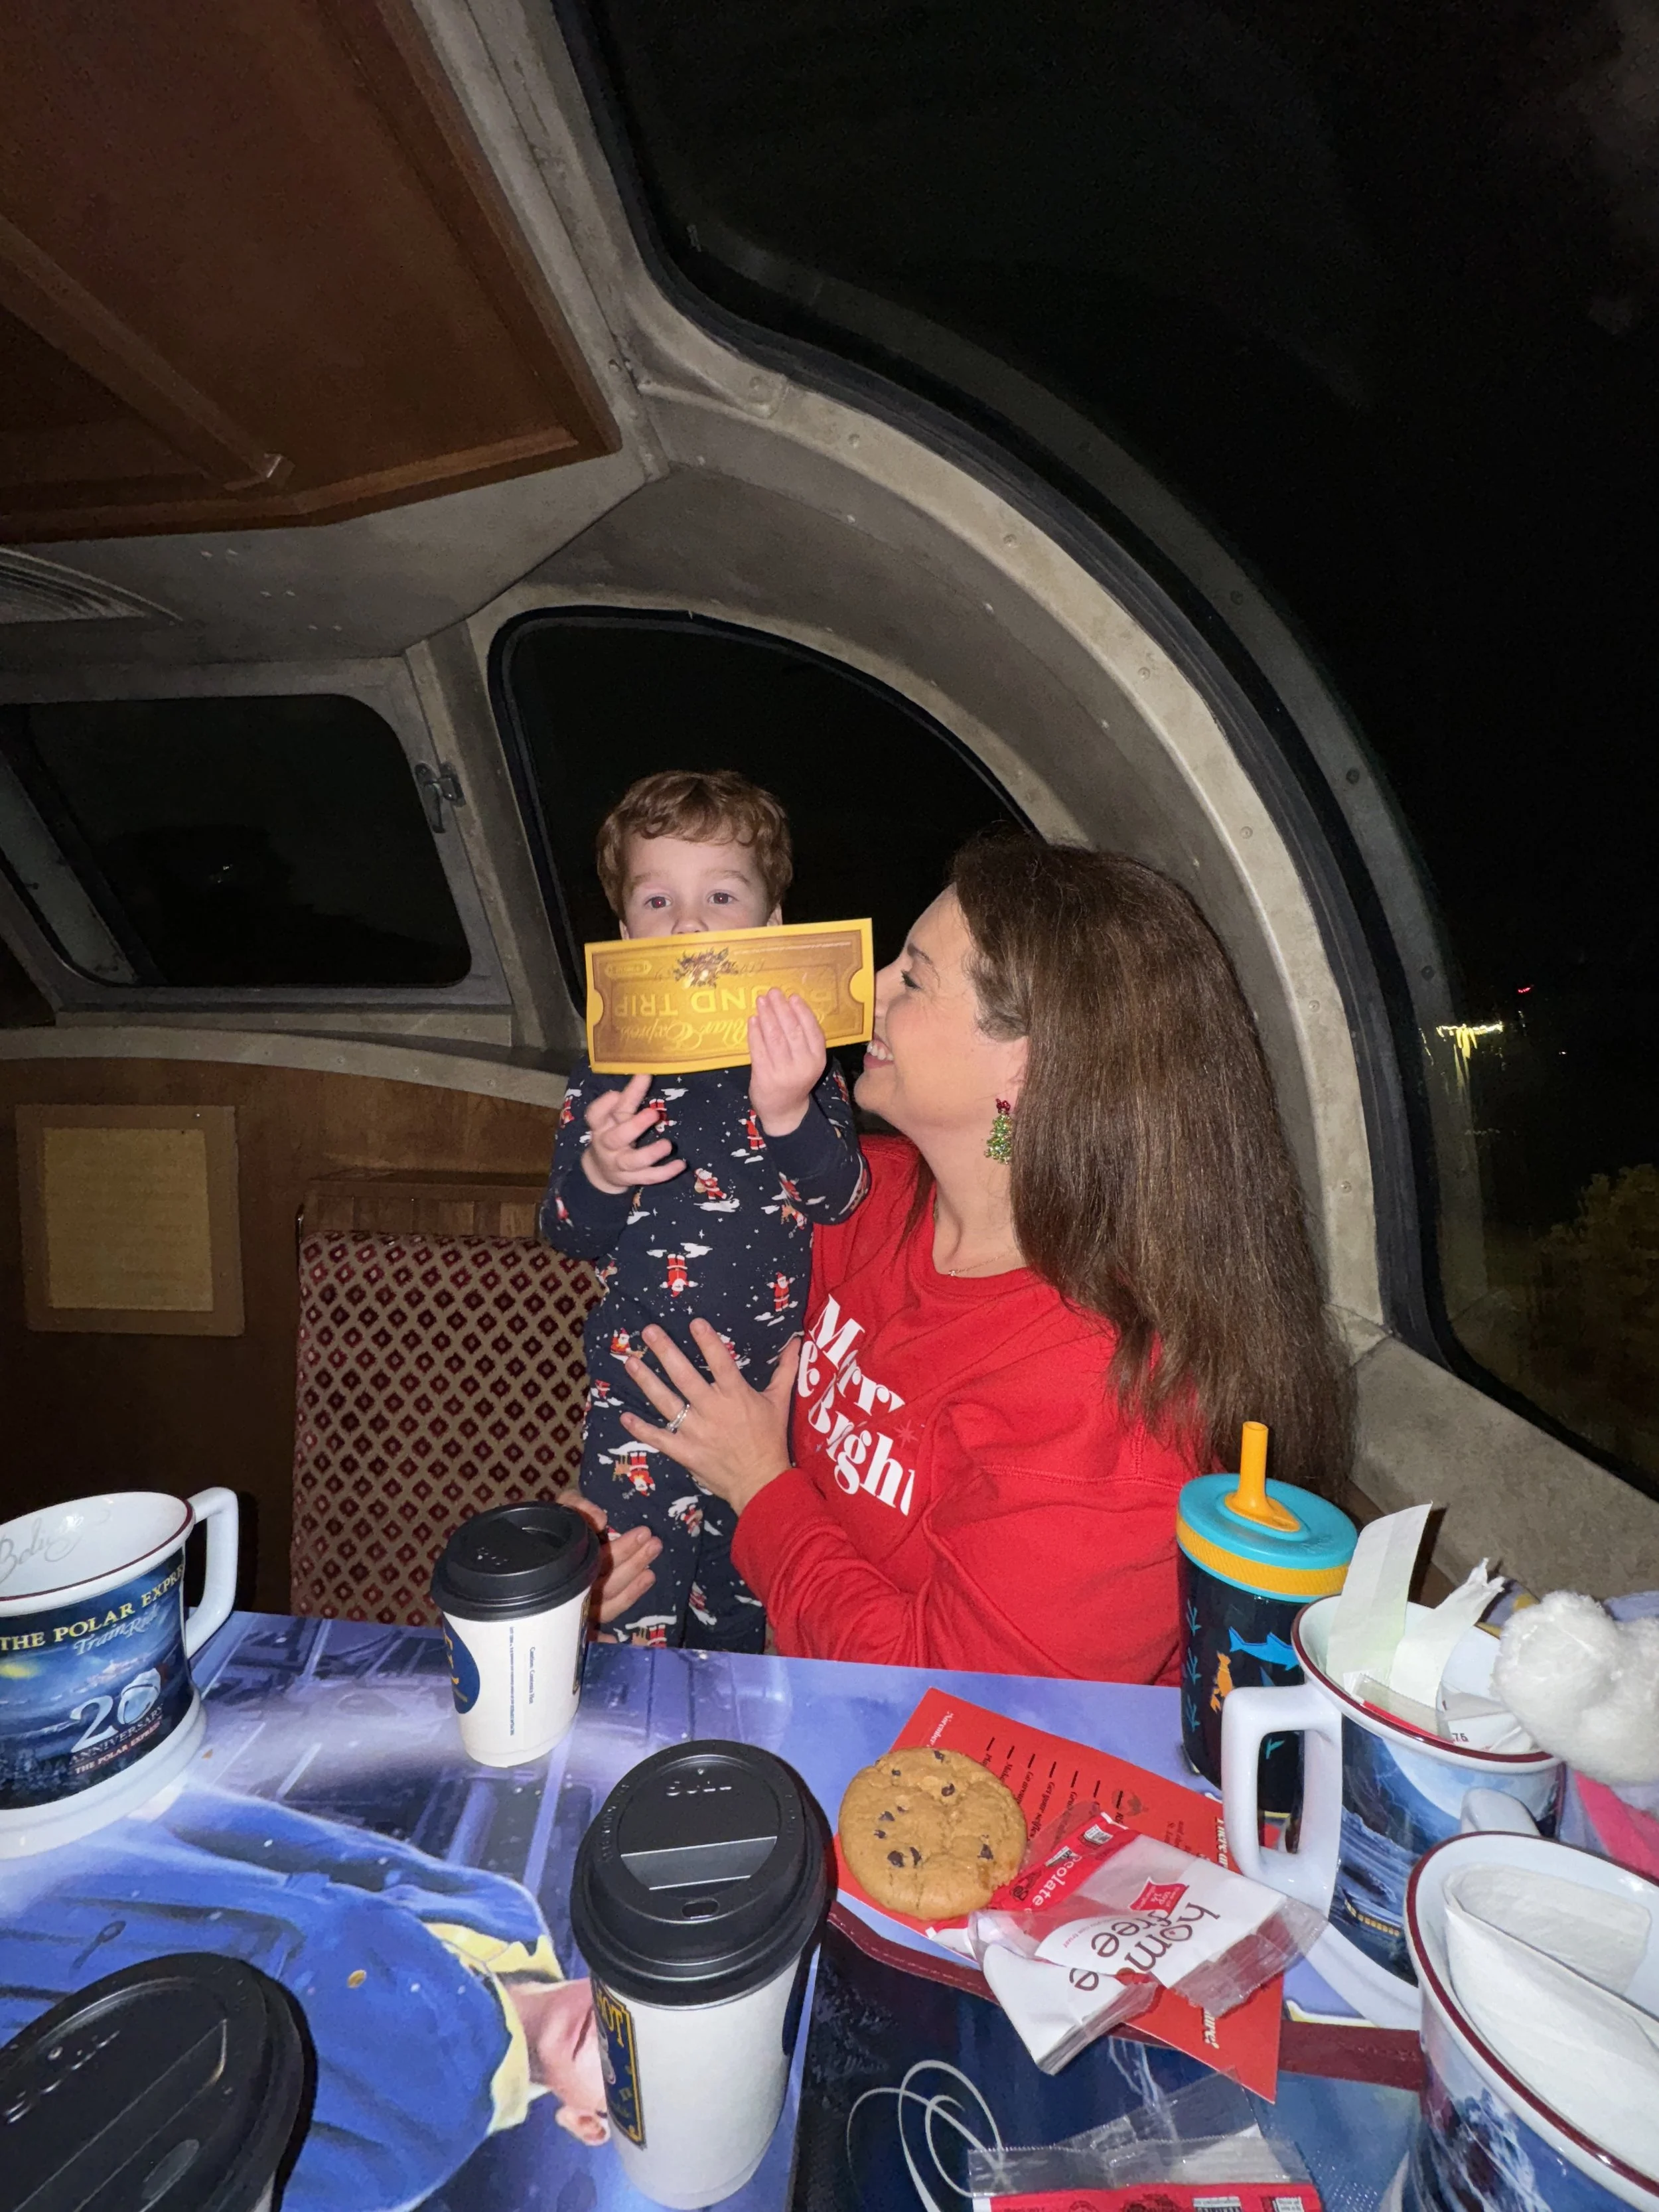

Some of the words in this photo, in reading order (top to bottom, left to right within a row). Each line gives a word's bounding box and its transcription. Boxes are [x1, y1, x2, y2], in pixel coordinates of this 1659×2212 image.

[614, 992, 678, 1017] TRIP
[0, 1631, 46, 1651] THE
[54, 1602, 135, 1643] POLAR
[73, 1622, 126, 1656] Train
[70, 1667, 161, 1753] 20
[75, 1761, 96, 1775] THE
[98, 1744, 129, 1765] POLAR
[1062, 1931, 1079, 1949] trust
[1091, 1910, 1172, 1958] free
